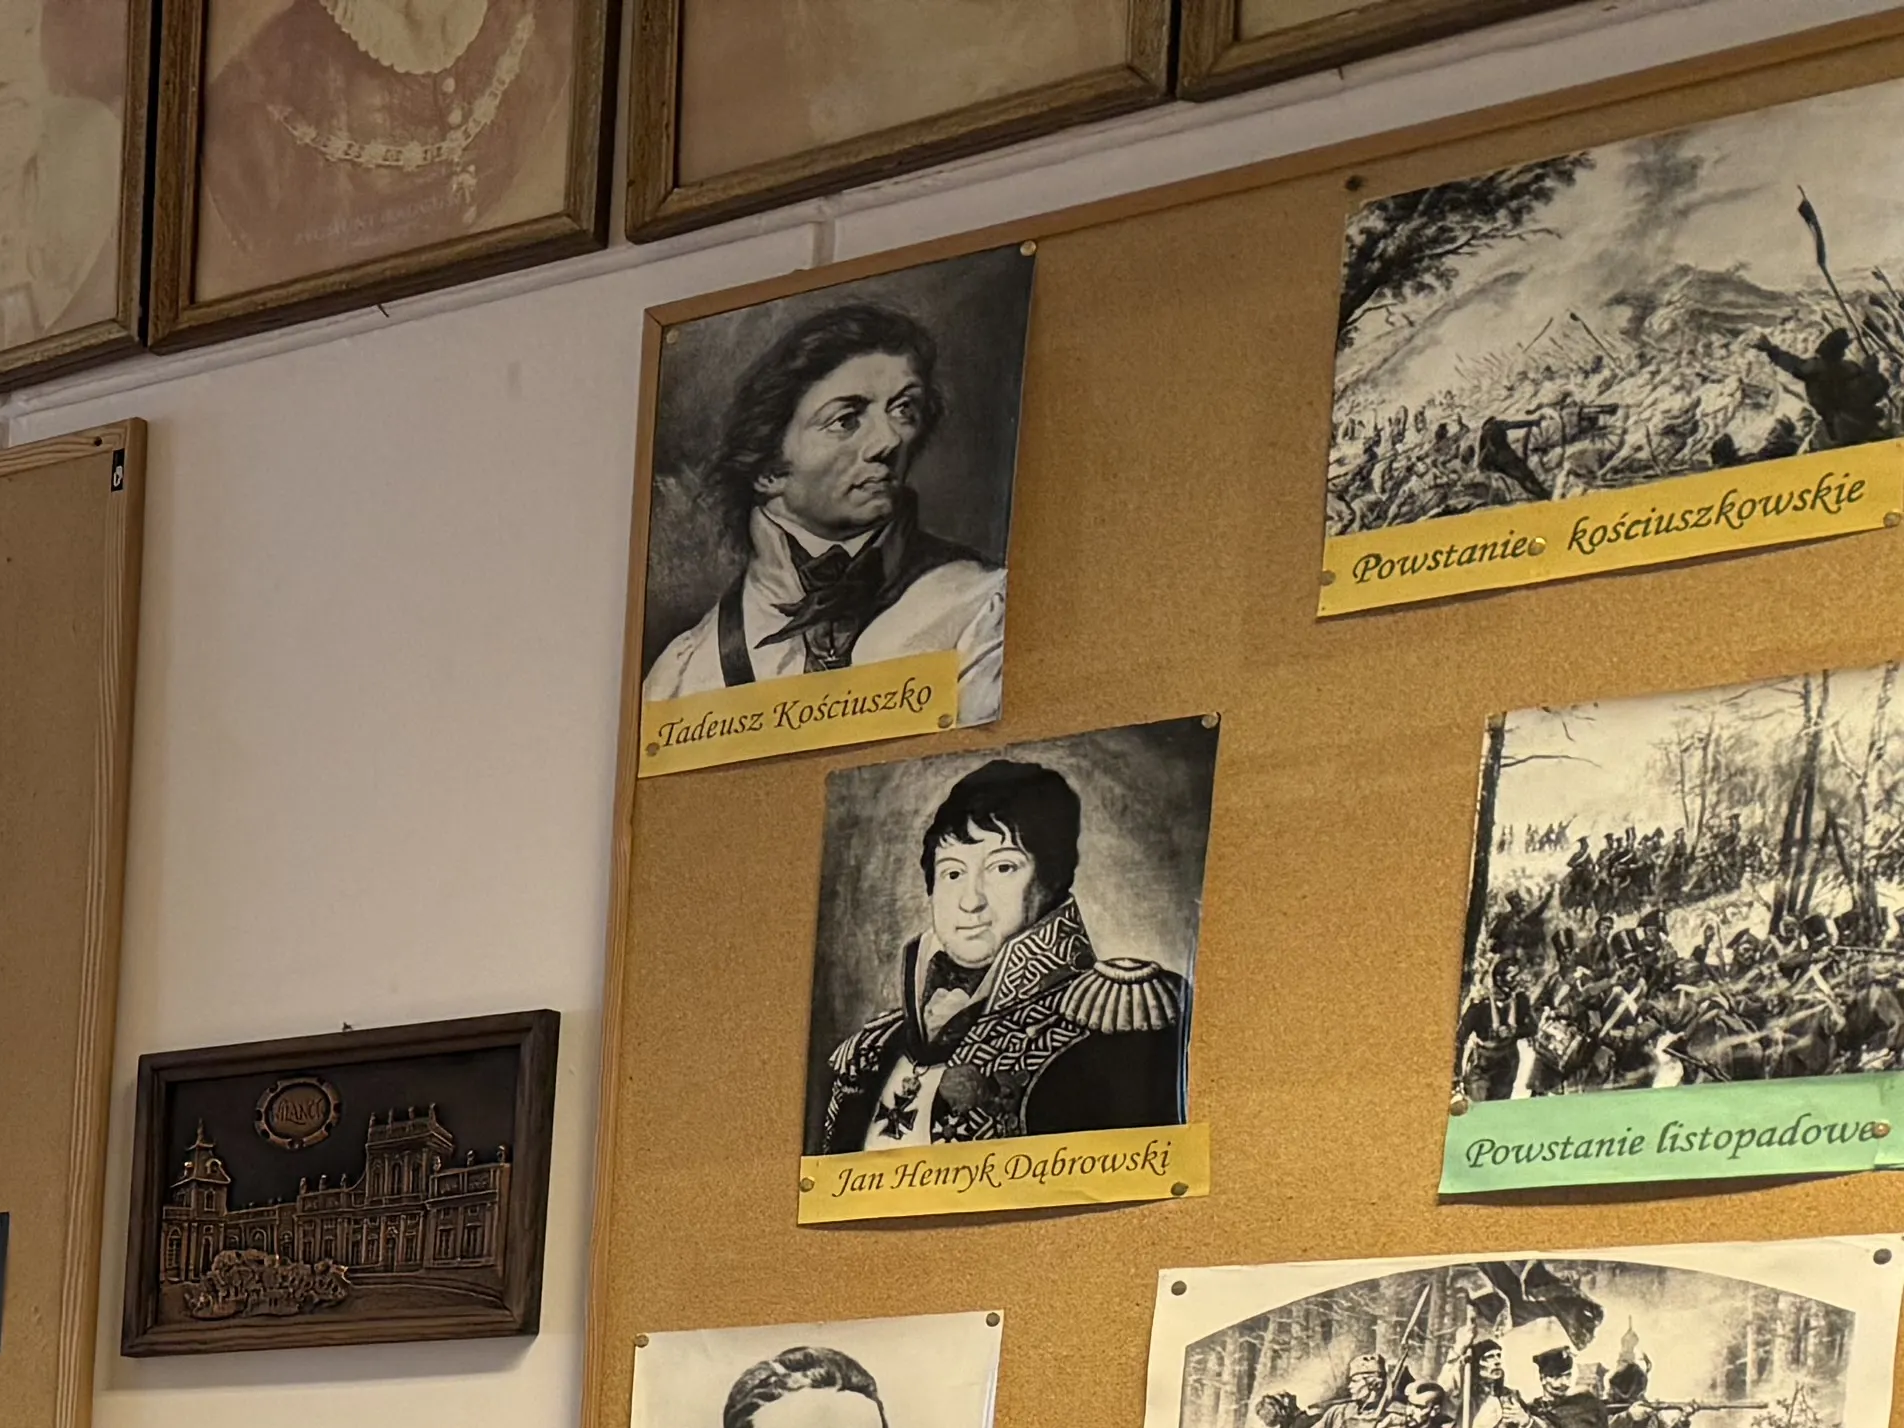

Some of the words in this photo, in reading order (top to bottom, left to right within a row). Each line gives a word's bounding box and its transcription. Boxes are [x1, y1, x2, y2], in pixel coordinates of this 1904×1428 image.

[1352, 529, 1531, 584] Powstanie
[1567, 472, 1866, 556] kościuszkowskie
[658, 711, 763, 747] Tadeusz
[773, 677, 932, 730] Kościuszko
[832, 1168, 884, 1197] Jan
[890, 1152, 1001, 1193] Henryk
[1004, 1139, 1171, 1184] Dąbrowski
[1466, 1126, 1645, 1168] Powstanie
[1655, 1112, 1876, 1160] listopadowe
